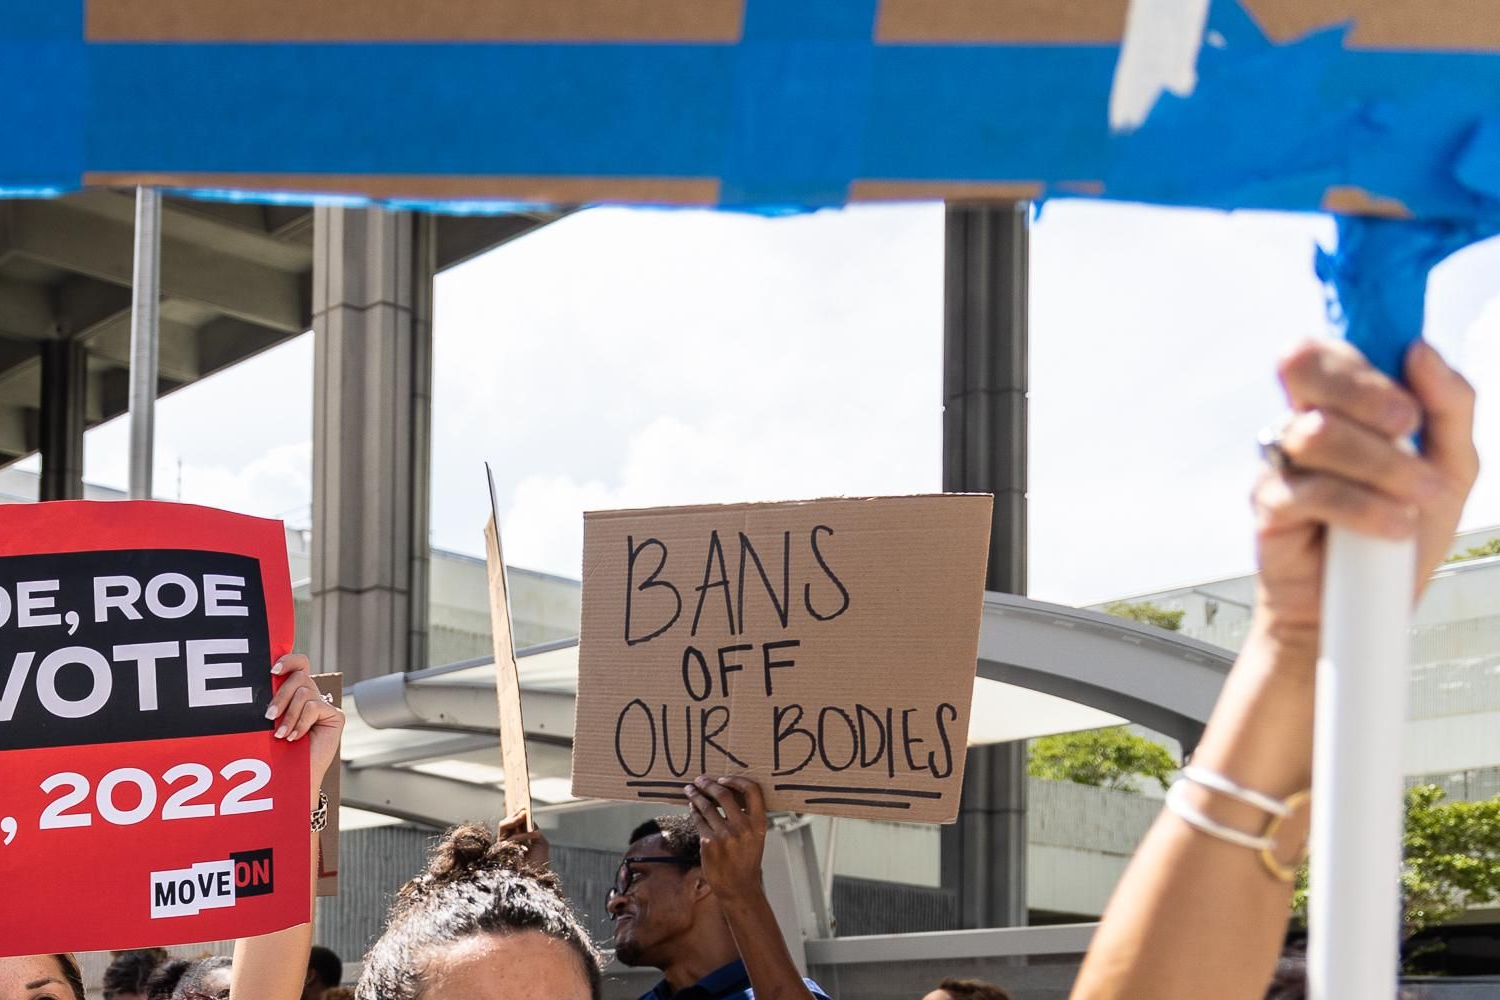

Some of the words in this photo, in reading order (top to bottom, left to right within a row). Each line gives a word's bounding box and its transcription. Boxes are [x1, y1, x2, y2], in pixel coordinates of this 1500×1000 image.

[93, 572, 249, 623] ROE
[625, 525, 850, 645] BANS
[682, 640, 800, 701] OFF
[615, 698, 748, 777] OUR
[771, 702, 957, 778] BODIES
[39, 758, 273, 830] 2022
[154, 858, 270, 907] MOVEON
